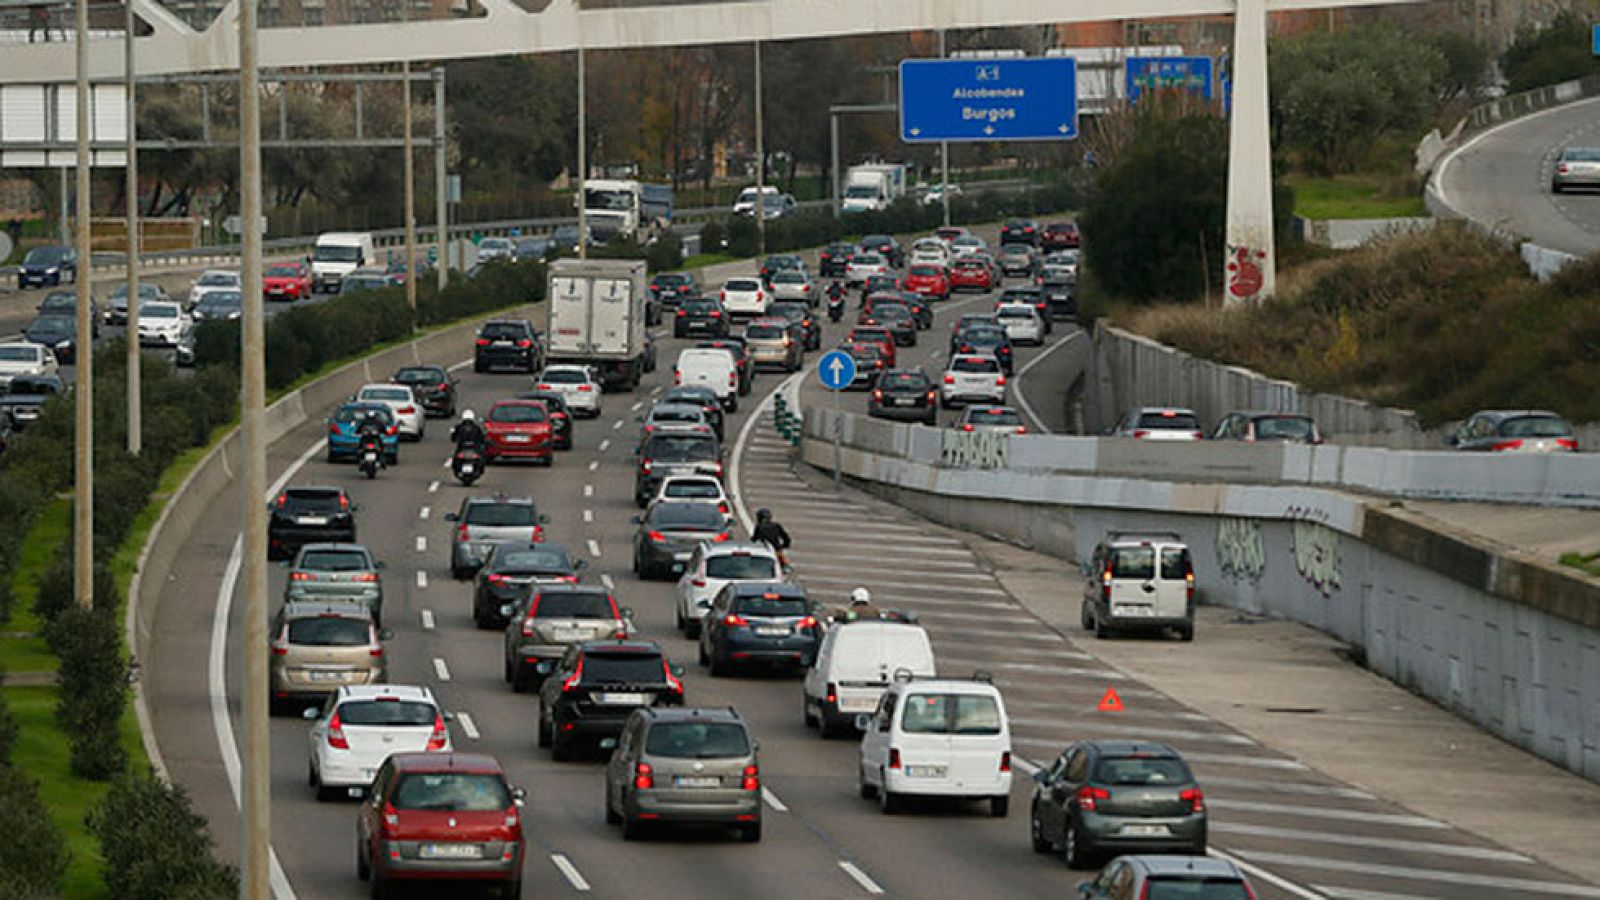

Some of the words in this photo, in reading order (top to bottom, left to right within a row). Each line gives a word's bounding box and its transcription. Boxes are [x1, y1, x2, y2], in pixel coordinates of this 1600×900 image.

[975, 64, 1000, 80] A-1
[952, 87, 1024, 98] Alcobendas
[962, 107, 1015, 122] Burgos
